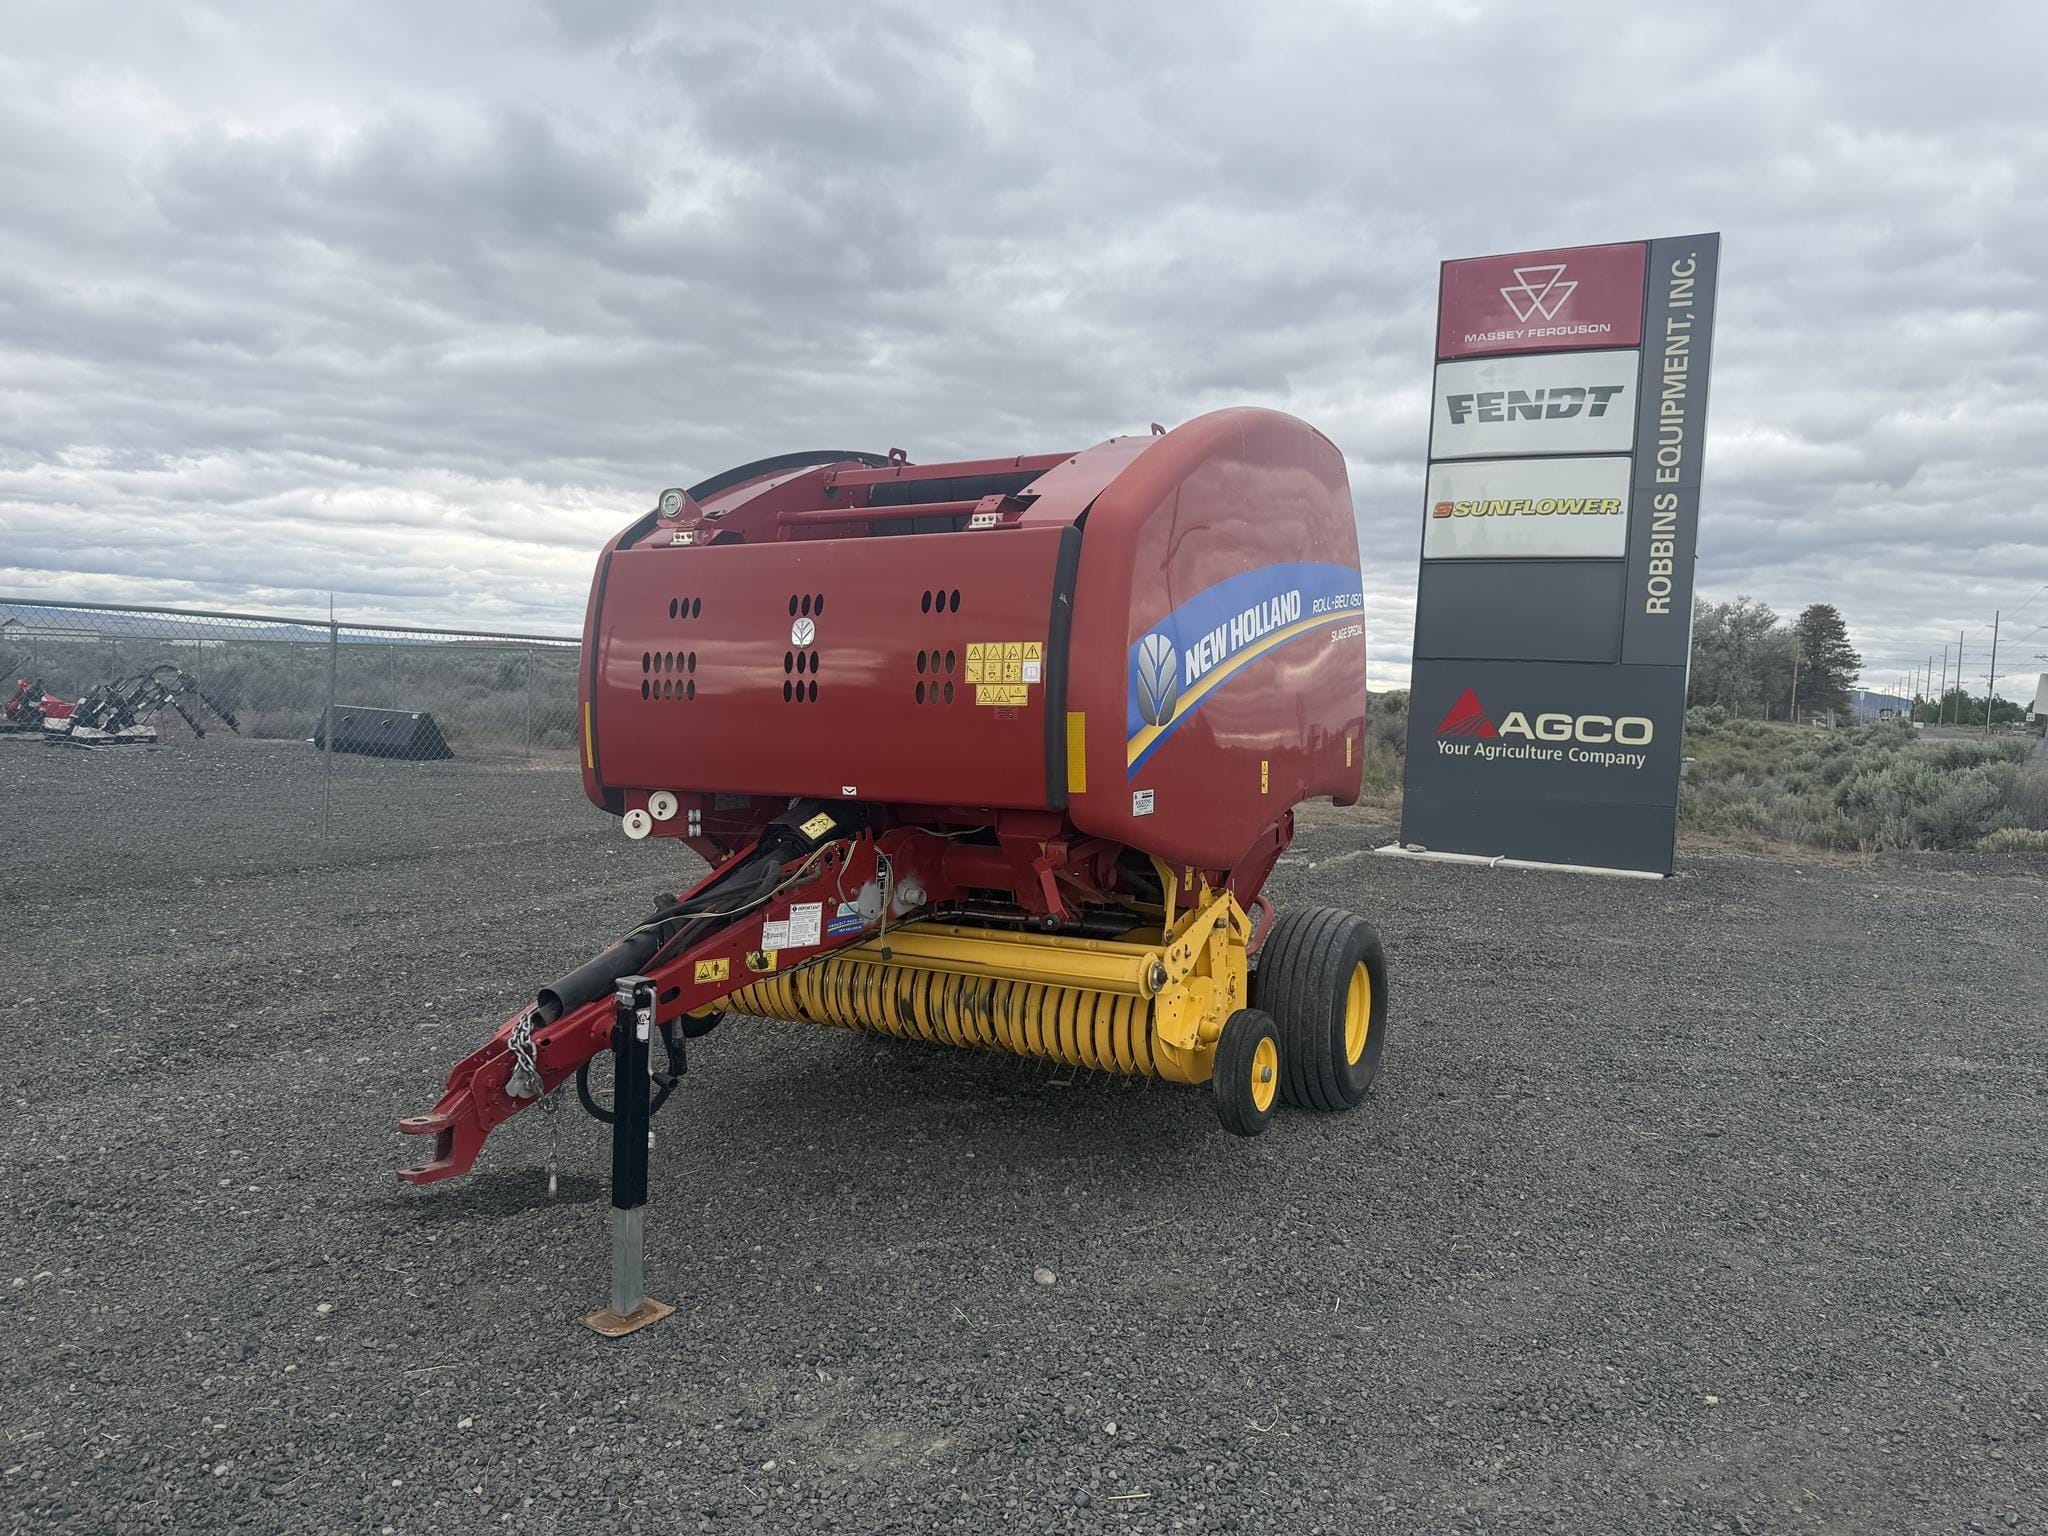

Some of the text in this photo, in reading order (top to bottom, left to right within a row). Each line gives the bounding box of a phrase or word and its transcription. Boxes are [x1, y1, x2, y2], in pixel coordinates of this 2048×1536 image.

[1464, 323, 1611, 343] MASSEY FERGUSON
[1446, 385, 1624, 424] FENDT
[1645, 252, 1697, 614] ROBBINS EQUIPMENT, INC.
[1312, 594, 1350, 615] ROLL-BELT
[1185, 589, 1301, 686] NEW HOLLAND
[1498, 711, 1654, 745] AGCO
[1437, 740, 1646, 769] Your Agriculture Company
